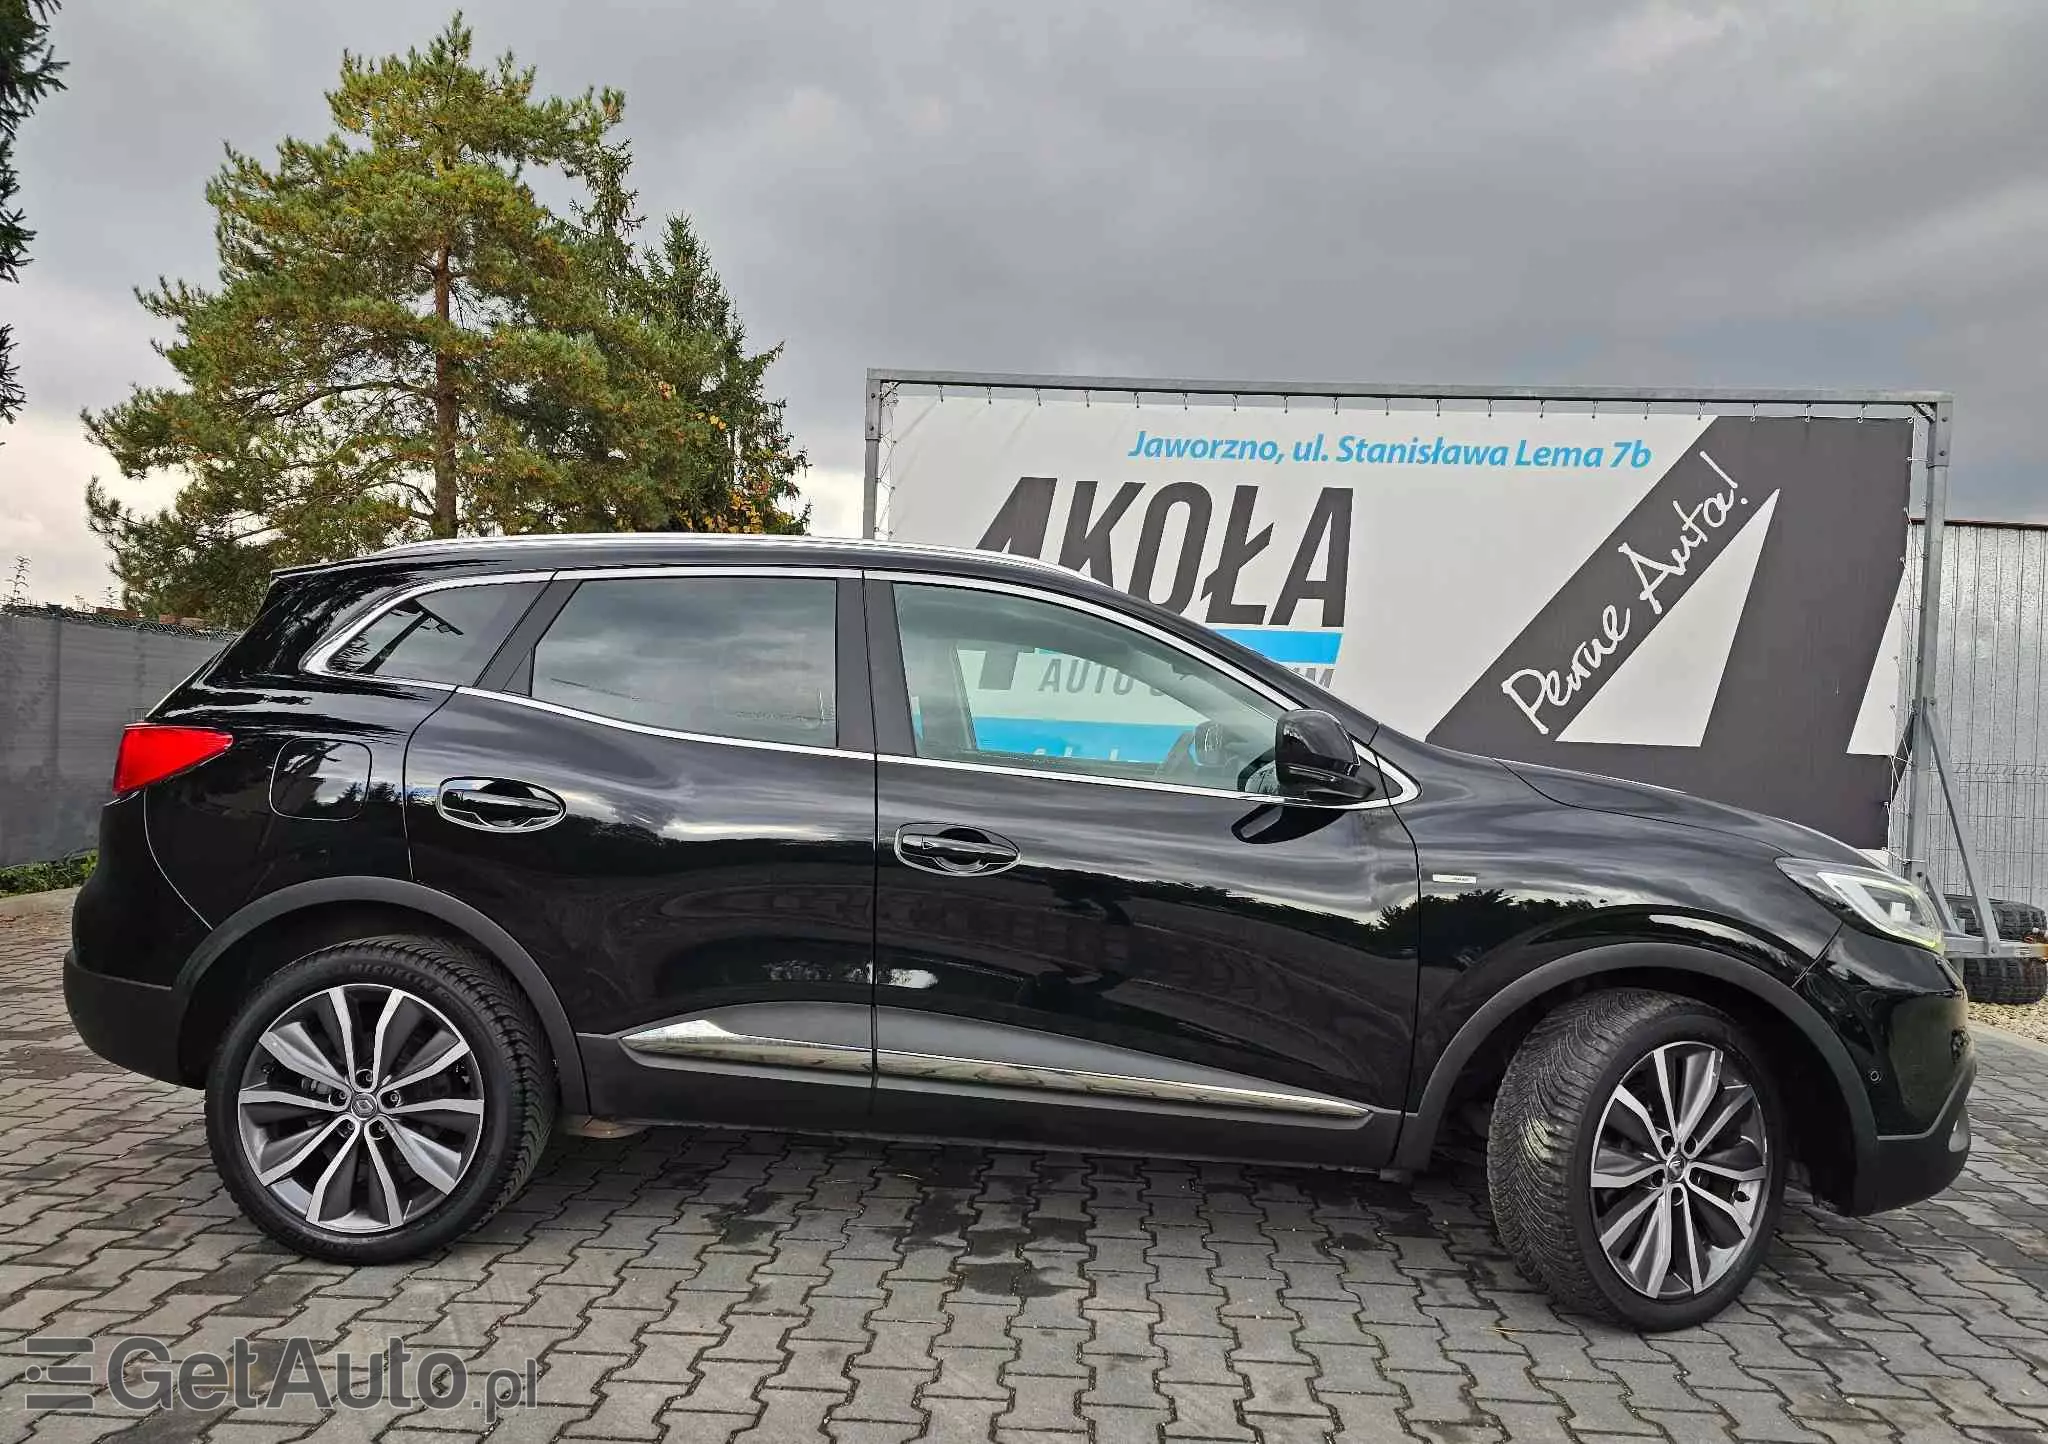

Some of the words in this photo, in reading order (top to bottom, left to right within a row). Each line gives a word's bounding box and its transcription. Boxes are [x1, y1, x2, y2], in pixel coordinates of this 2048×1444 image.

[1127, 430, 1285, 465] Jaworzno,
[1292, 432, 1329, 462] ul.
[1335, 434, 1509, 466] Stanisława
[1514, 439, 1604, 468] Lema
[1609, 439, 1653, 468] 7b
